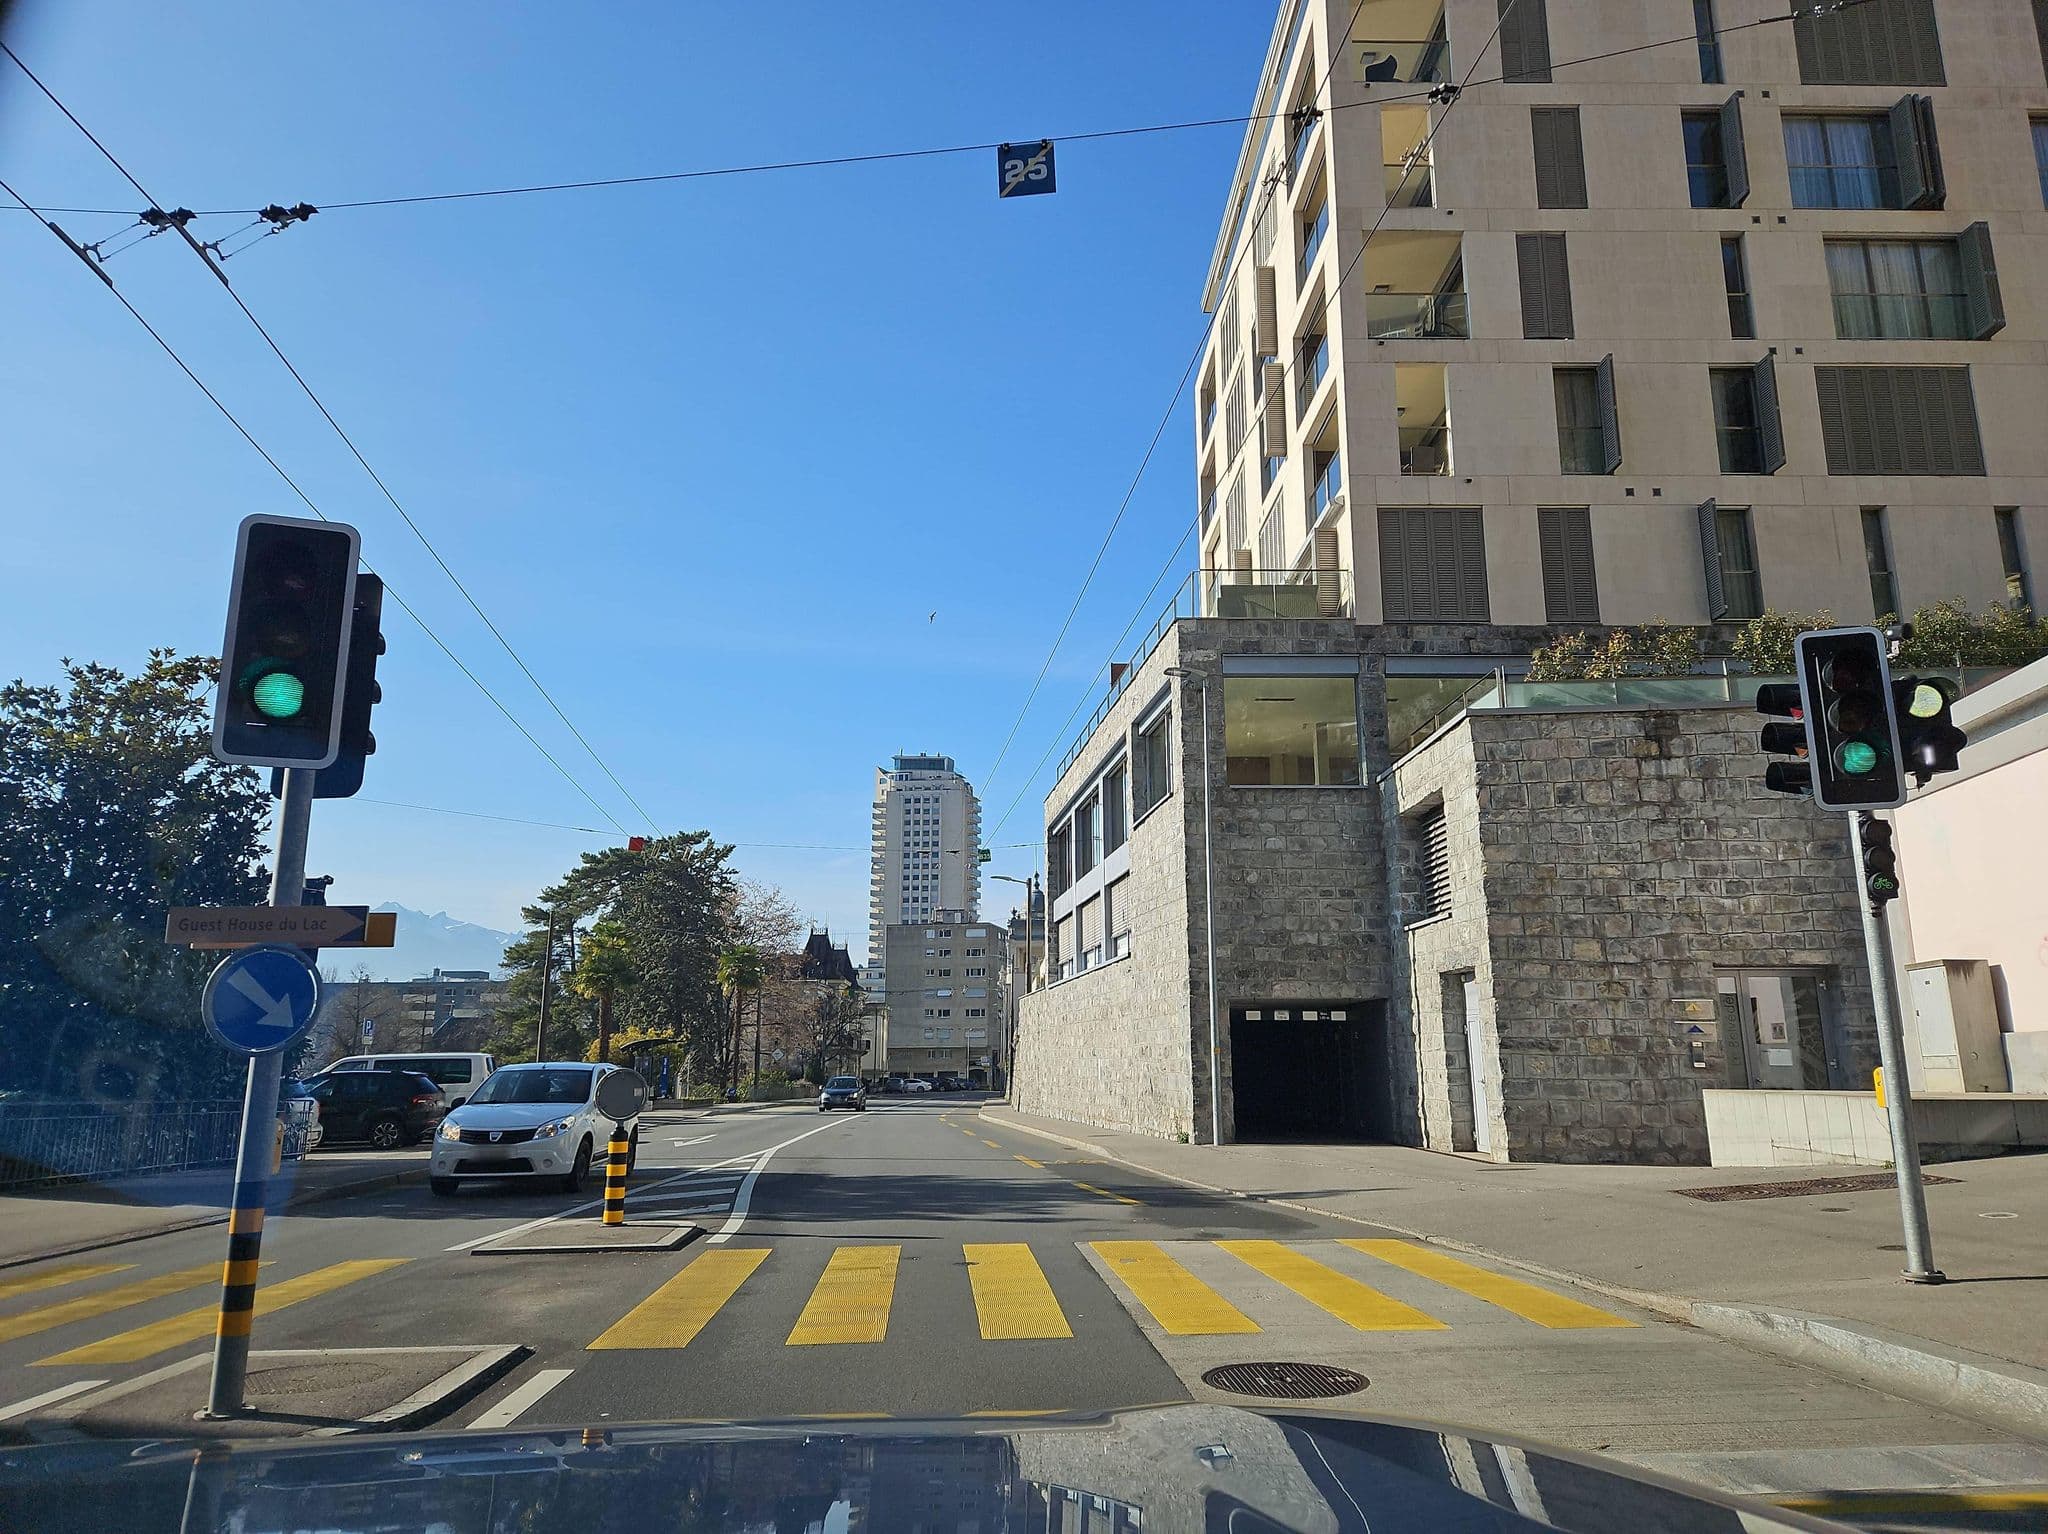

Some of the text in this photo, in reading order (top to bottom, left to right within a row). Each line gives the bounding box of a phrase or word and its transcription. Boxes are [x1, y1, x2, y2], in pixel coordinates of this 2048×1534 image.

[1005, 156, 1048, 183] 25
[178, 917, 327, 932] Guest House du Lac
[366, 1020, 372, 1034] P
